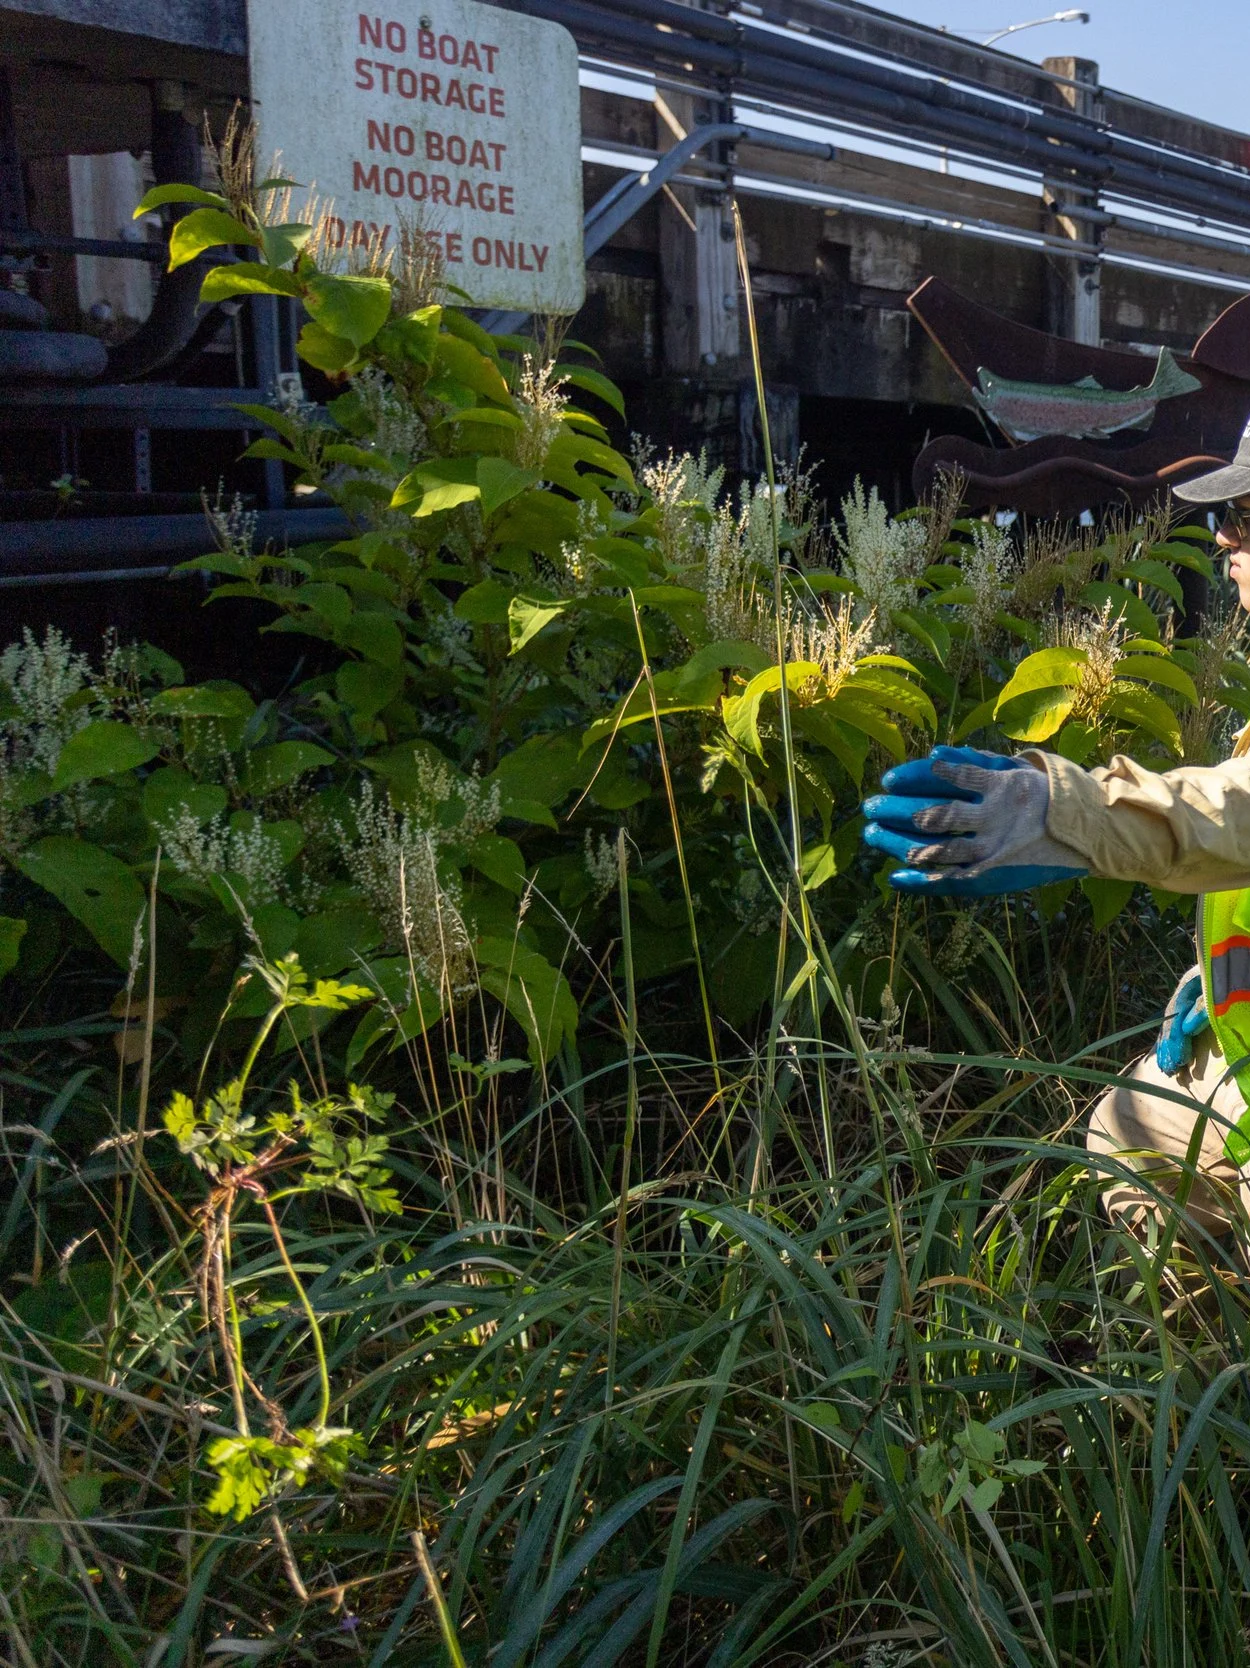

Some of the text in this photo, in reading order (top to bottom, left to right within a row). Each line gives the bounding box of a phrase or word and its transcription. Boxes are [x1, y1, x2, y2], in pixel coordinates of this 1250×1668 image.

[359, 14, 500, 74] NO BOAT
[355, 57, 506, 118] STORAGE
[367, 119, 507, 172] NO BOAT
[353, 160, 515, 216] MOORAGE
[325, 215, 392, 254] DAY
[472, 236, 550, 273] ONLY
